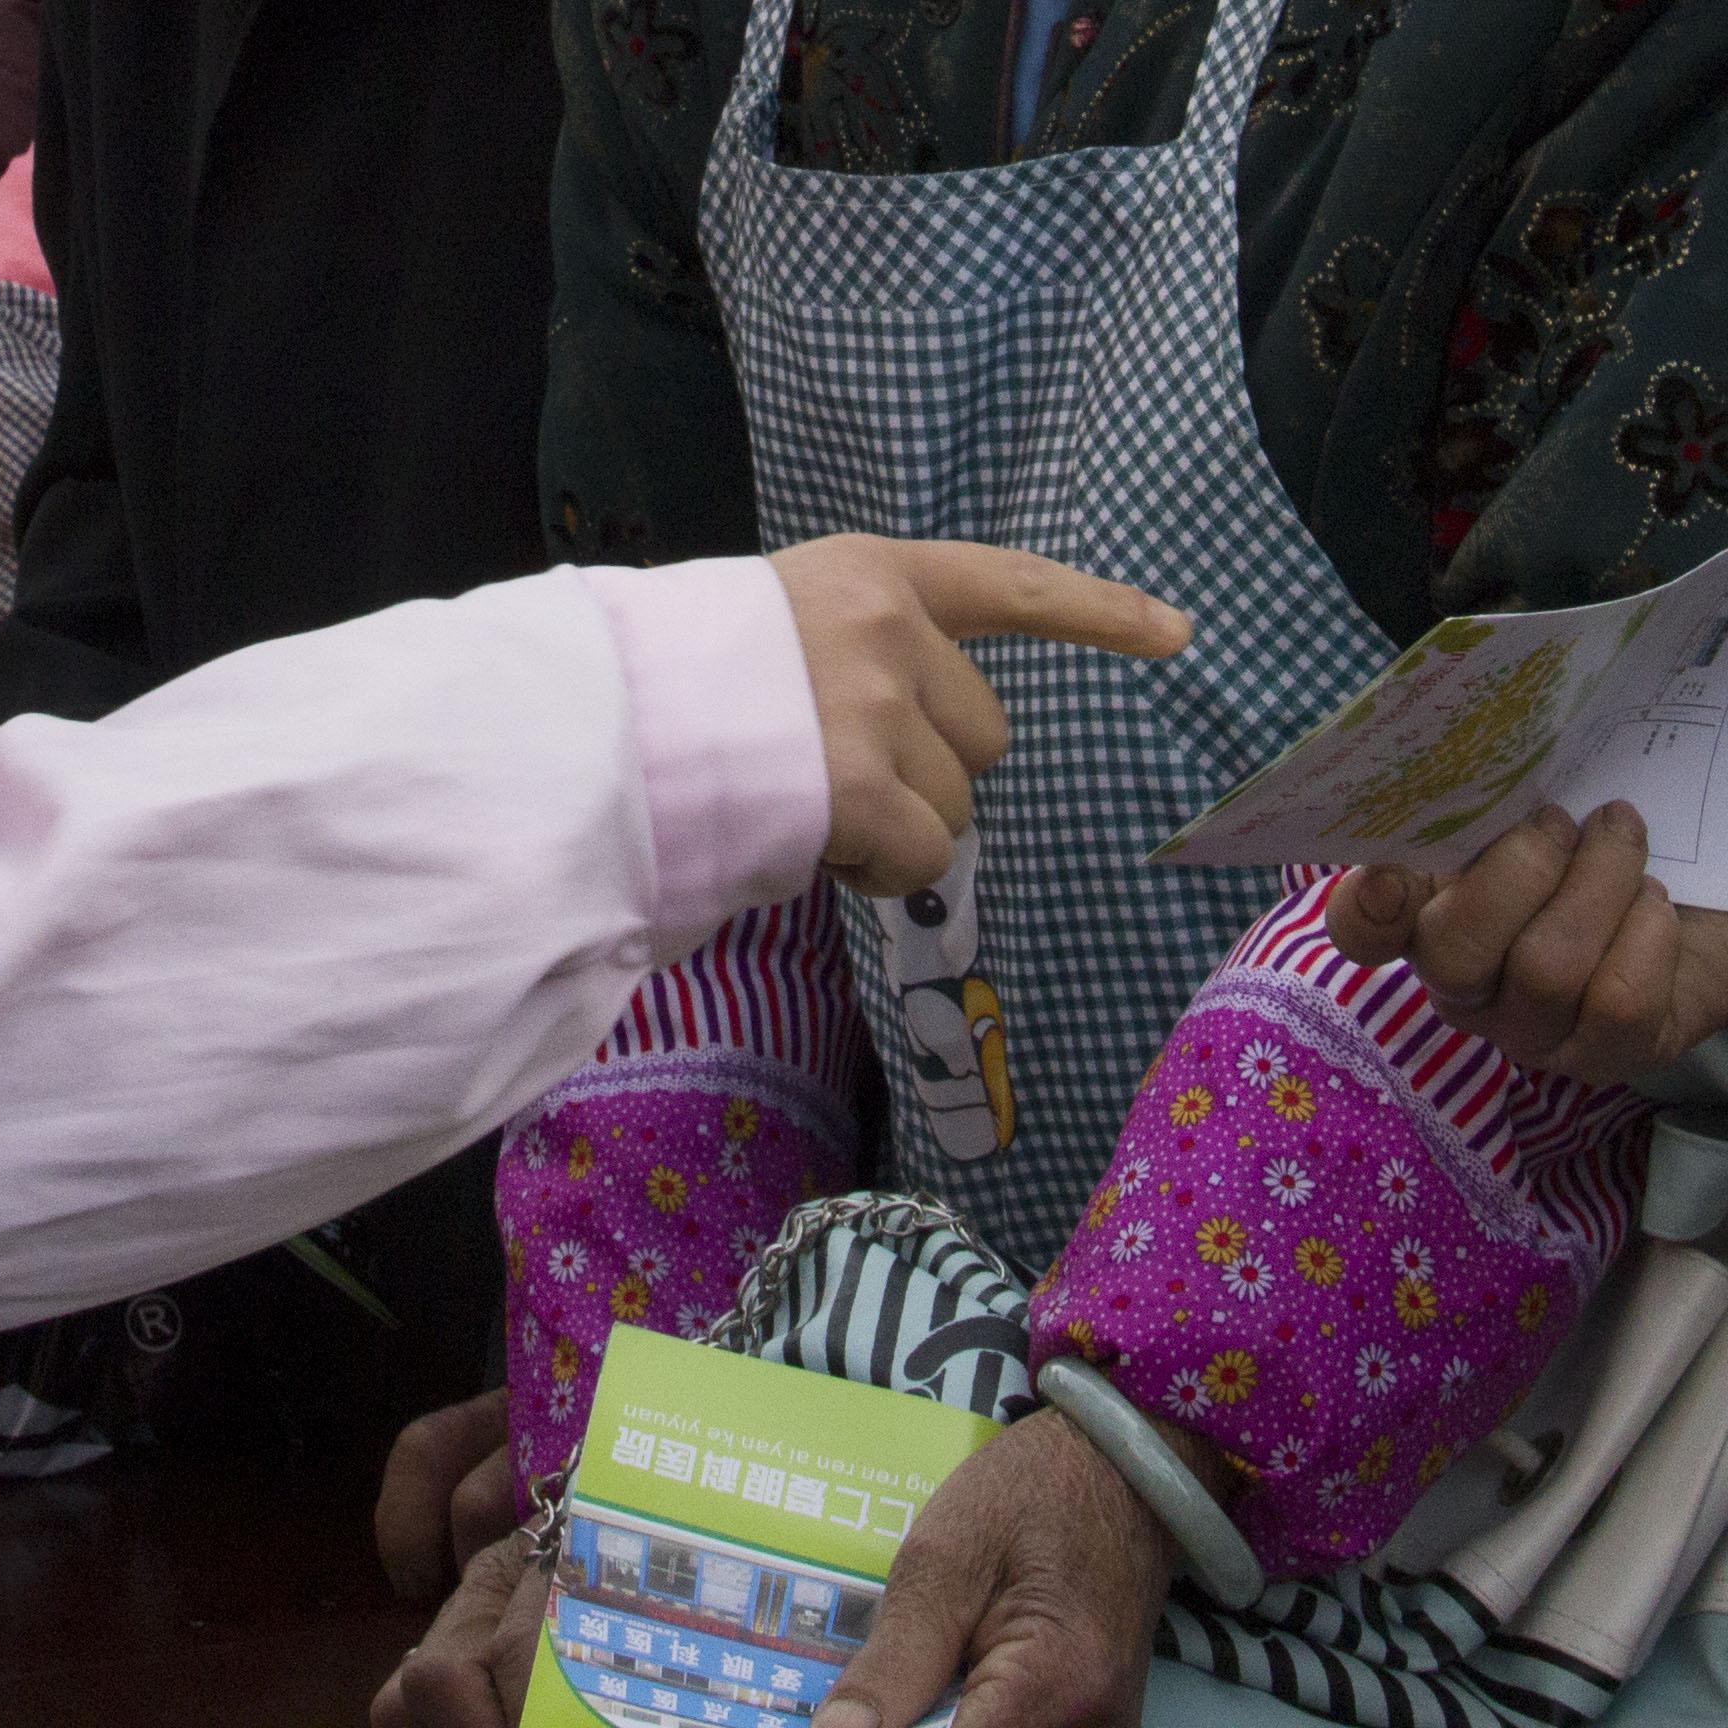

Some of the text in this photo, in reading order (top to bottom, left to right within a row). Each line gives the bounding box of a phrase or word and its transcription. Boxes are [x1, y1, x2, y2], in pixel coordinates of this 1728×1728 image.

[578, 1613, 835, 1693] 爱眼科医院
